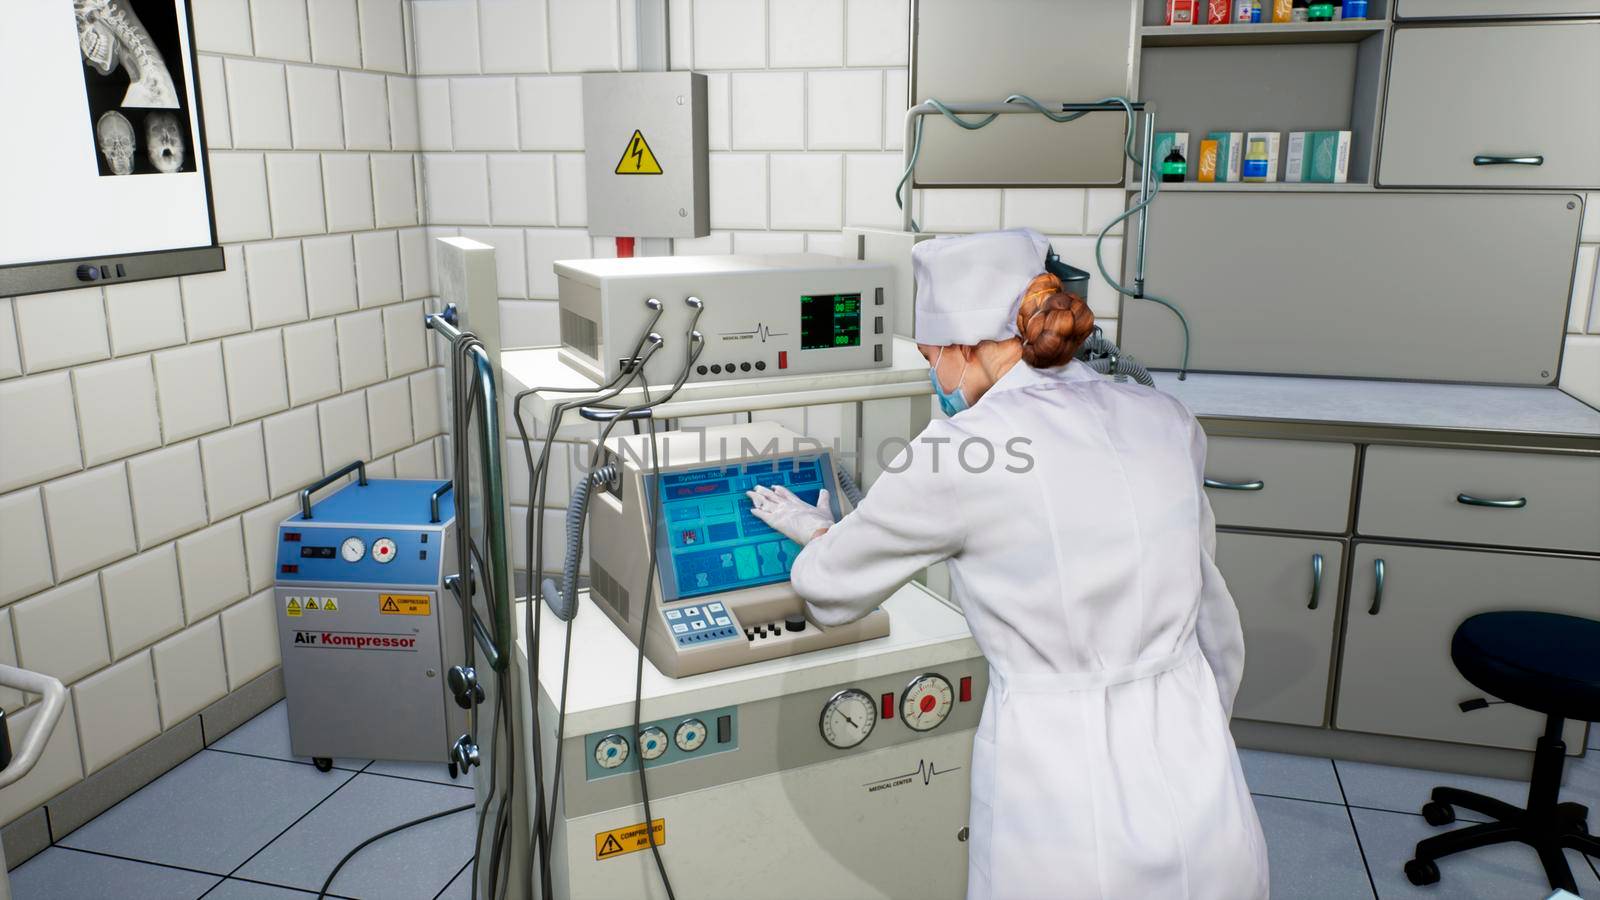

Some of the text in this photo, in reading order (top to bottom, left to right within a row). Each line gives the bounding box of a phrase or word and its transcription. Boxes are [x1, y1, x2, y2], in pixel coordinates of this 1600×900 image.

[678, 471, 726, 482] System Stop
[294, 632, 416, 649] Air Kompressor
[869, 778, 913, 792] MEDICAL CENTER
[636, 837, 648, 846] AIR
